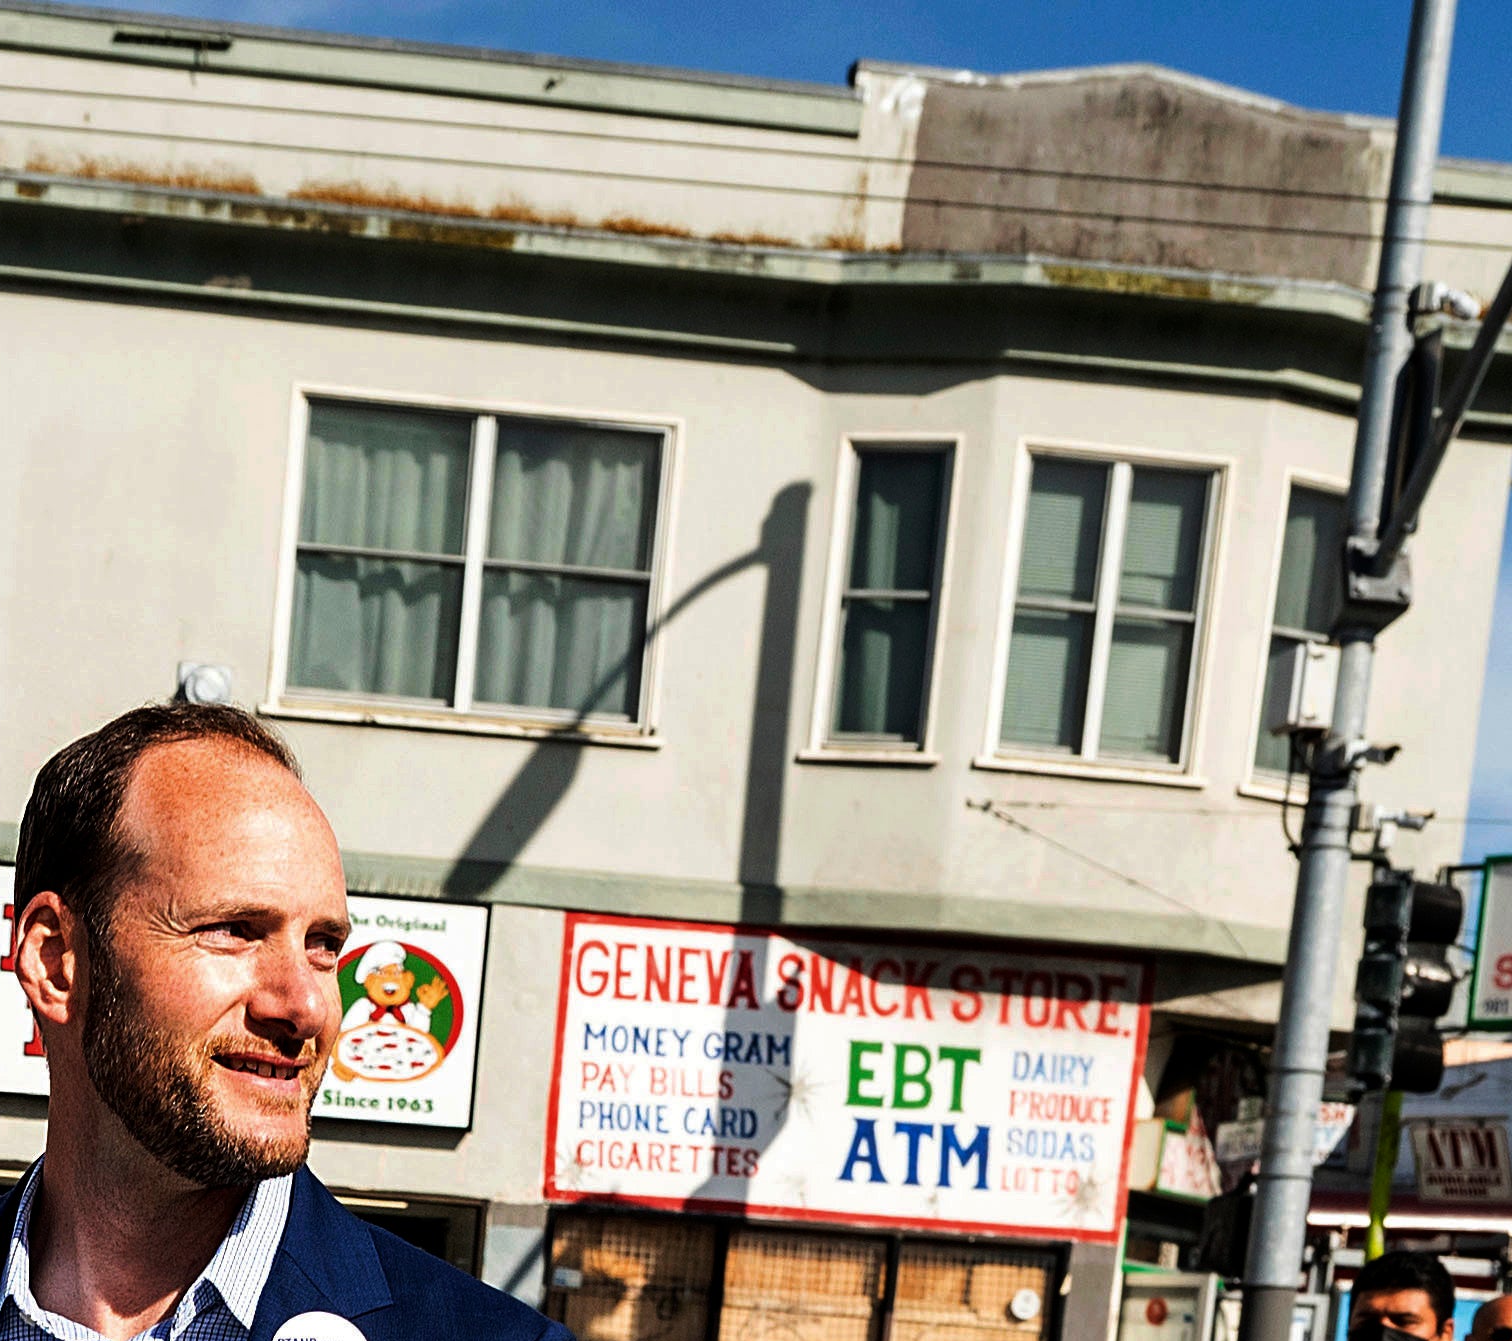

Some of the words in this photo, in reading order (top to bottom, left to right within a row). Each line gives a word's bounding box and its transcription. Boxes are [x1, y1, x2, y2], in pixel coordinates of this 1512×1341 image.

[375, 914, 447, 933] Original
[576, 939, 761, 1012] GENEVA
[777, 951, 935, 1022] SNACK
[582, 1023, 692, 1058] MONEY
[703, 1031, 793, 1067] GRAM
[580, 1062, 638, 1095] PAY
[649, 1065, 734, 1100] BILLS
[844, 1039, 983, 1113] EBT
[1012, 1051, 1095, 1087] DAIRY
[322, 1088, 379, 1110] Since
[387, 1096, 435, 1114] 1963
[578, 1100, 670, 1136] PHONE
[683, 1105, 759, 1140] CARD
[1008, 1088, 1113, 1126] PRODUCE
[575, 1140, 760, 1178] CIGARETTES
[837, 1117, 991, 1191] ATM
[1005, 1127, 1097, 1162] SODAS
[1426, 1127, 1499, 1169] ATM
[999, 1166, 1080, 1196] LOTTO
